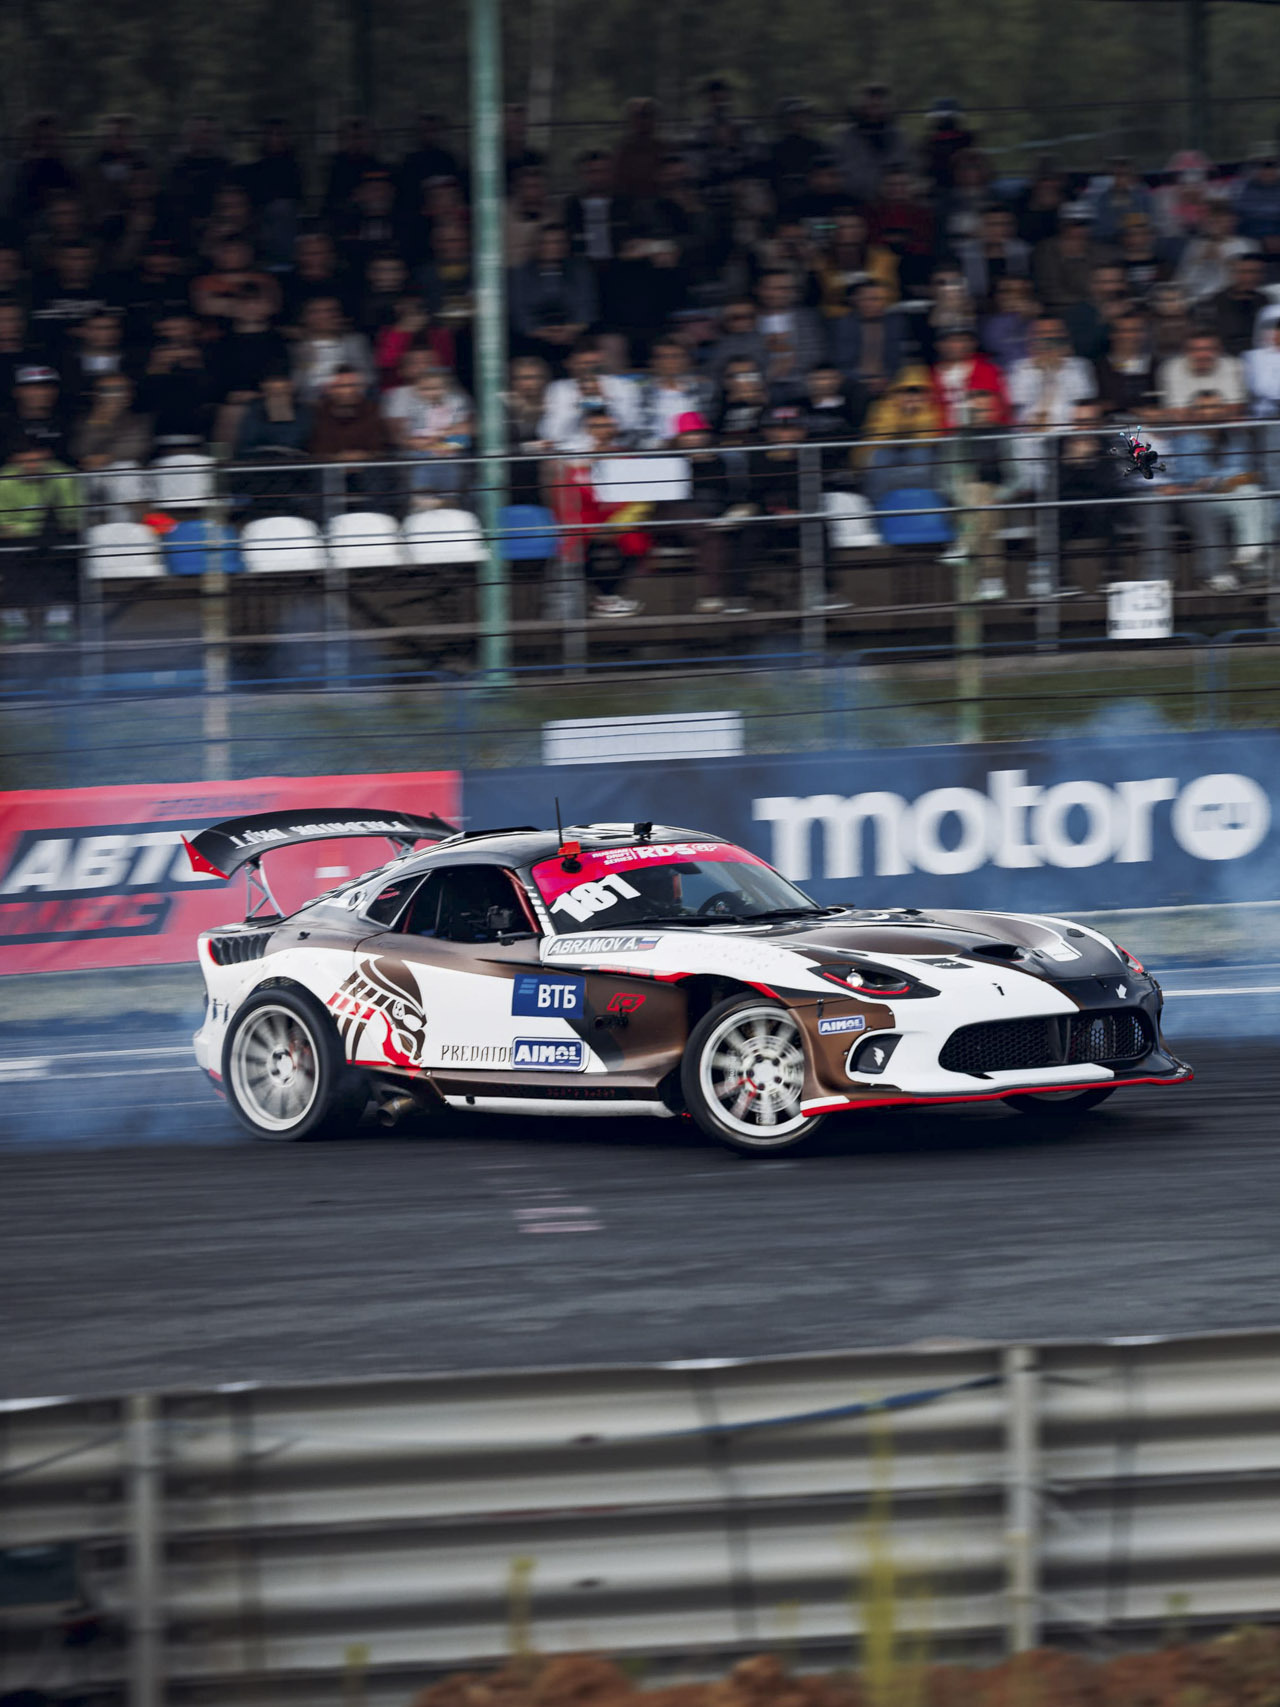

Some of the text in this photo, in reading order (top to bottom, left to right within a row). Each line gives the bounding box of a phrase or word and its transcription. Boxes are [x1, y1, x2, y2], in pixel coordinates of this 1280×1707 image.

[751, 770, 1179, 882] motor
[633, 844, 696, 859] RDS
[550, 873, 641, 923] 181
[551, 937, 624, 953] ABRAMOV
[538, 984, 577, 1009] ВТБ
[514, 1043, 581, 1064] AIMOL
